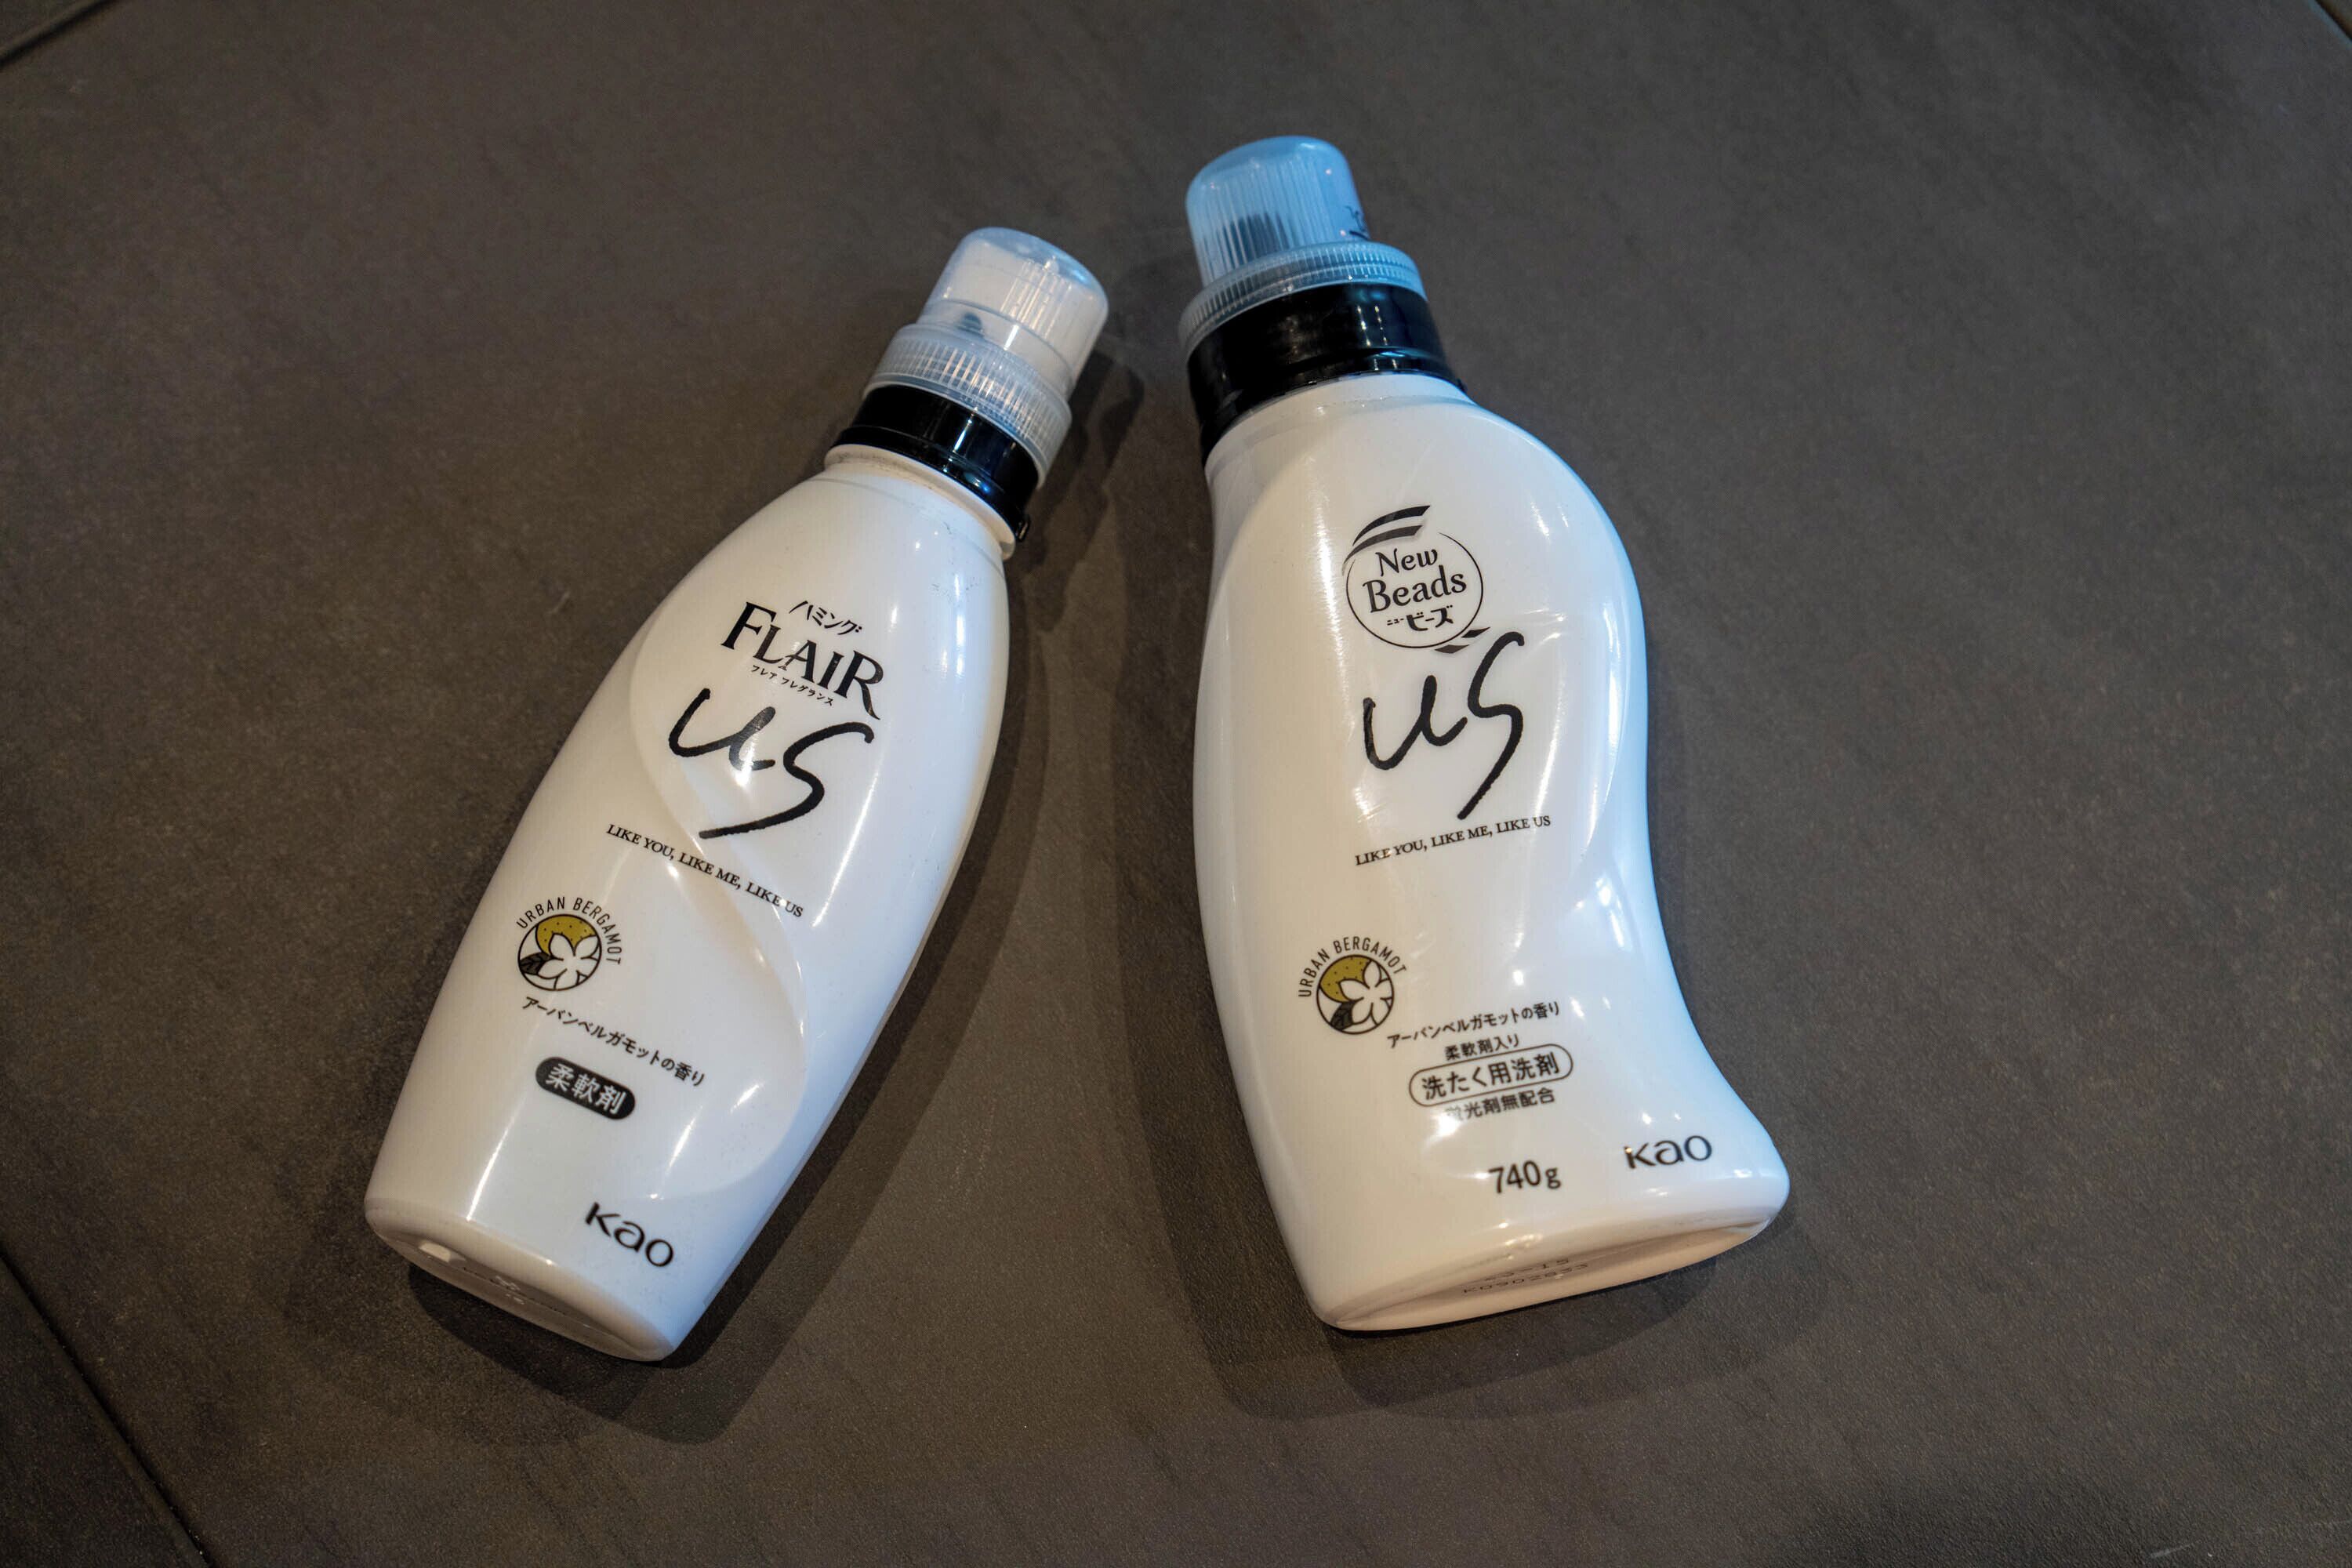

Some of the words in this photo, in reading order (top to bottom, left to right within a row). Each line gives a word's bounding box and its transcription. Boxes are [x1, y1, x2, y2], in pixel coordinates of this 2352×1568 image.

[1375, 548, 1438, 577] New
[1362, 564, 1467, 613] Beads
[789, 601, 862, 635] ハミング
[720, 601, 884, 720] FLAIR
[1355, 848, 1391, 866] LIKE
[1393, 840, 1428, 856] YOU,
[1431, 831, 1465, 848] LIKE
[1467, 826, 1493, 840] ME,
[1496, 818, 1530, 833] LIKE
[1533, 815, 1551, 828] US
[606, 824, 642, 845] LIKE
[643, 837, 675, 861] YOU,
[677, 852, 715, 875] LIKE
[714, 868, 741, 890] ME,
[745, 881, 781, 907] LIKE
[785, 901, 804, 917] US
[516, 896, 565, 929] URBAN
[572, 897, 622, 965] BERGAMOT
[1298, 948, 1330, 997] URBAN
[1333, 936, 1407, 975] BERGAMOT
[522, 996, 705, 1087] アーバンベルガモットの香り
[1387, 1000, 1559, 1049] アーバンベルガモットの香り
[1444, 1033, 1520, 1061] 柔軟剤入り
[546, 1063, 627, 1114] 柔軟剤
[1421, 1051, 1560, 1100] 洗たく用洗剤
